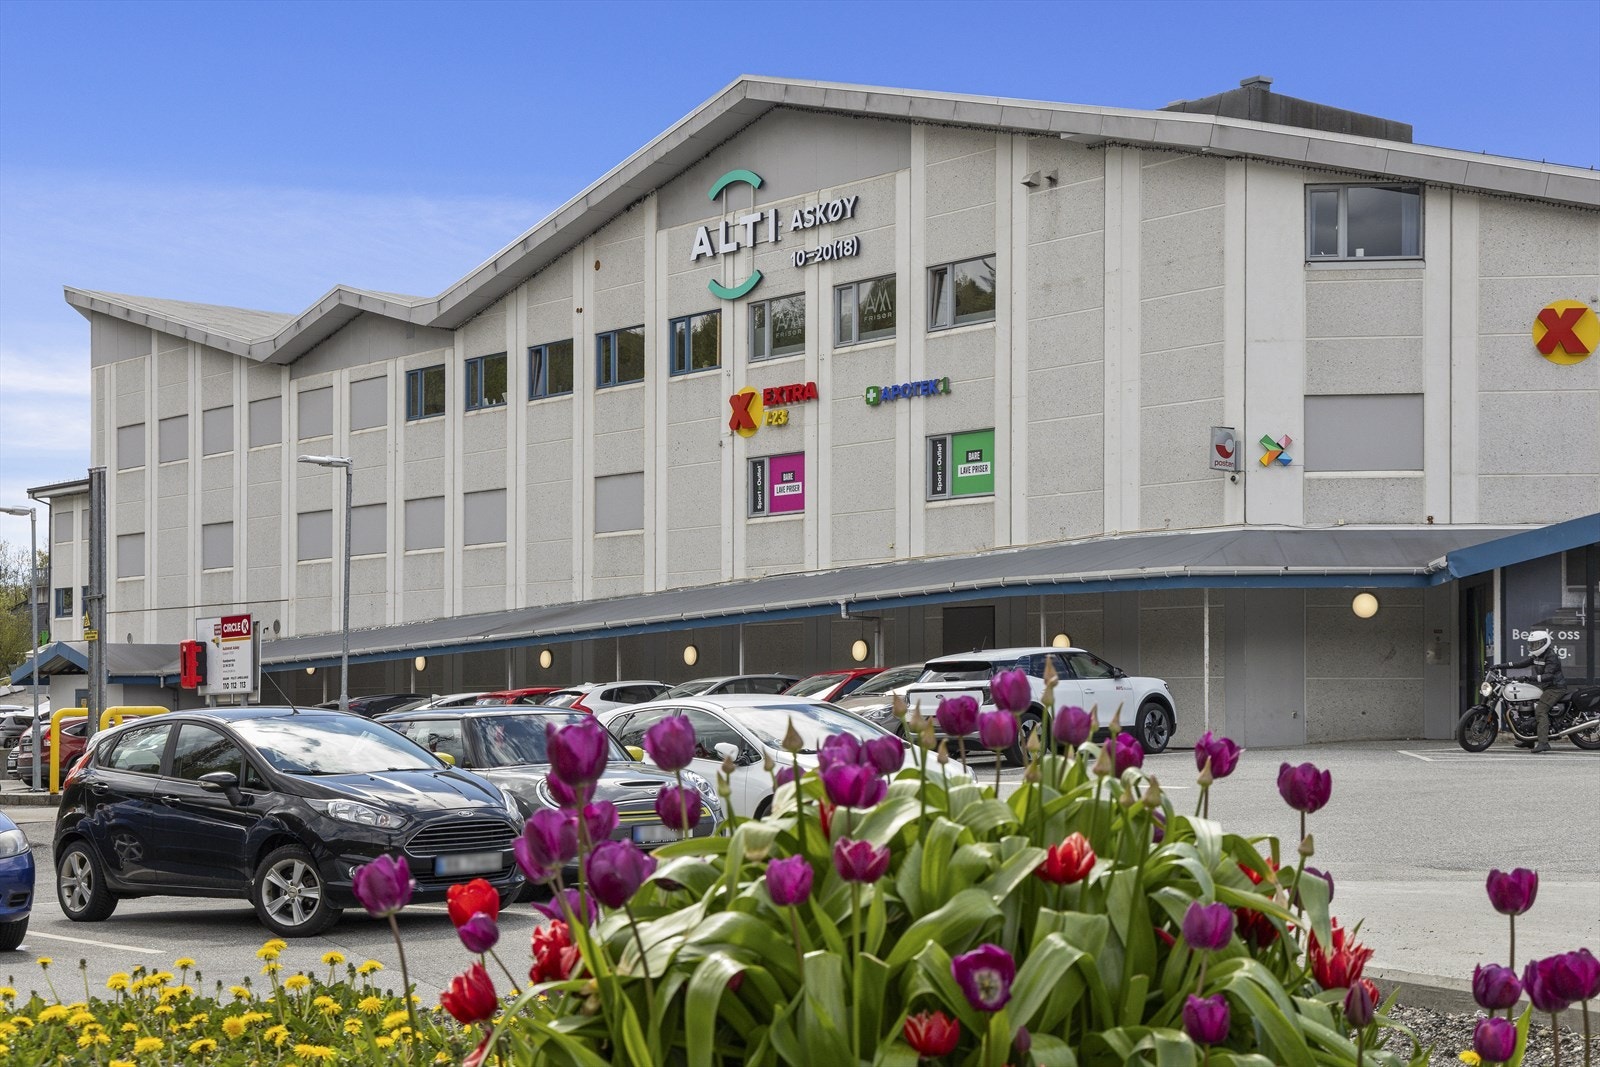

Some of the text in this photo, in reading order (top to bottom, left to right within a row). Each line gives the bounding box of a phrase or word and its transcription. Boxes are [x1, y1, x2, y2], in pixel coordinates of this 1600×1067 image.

[790, 195, 859, 231] ASKØY
[690, 208, 779, 261] ALTI
[864, 312, 893, 322] FRISØR
[763, 382, 818, 406] EXTRA
[880, 379, 940, 403] APOTEK
[968, 451, 981, 461] BARE
[960, 464, 988, 475] LAVE PRISER
[223, 622, 241, 633] CIRCLE
[1512, 628, 1580, 641] Bek oss
[1520, 645, 1524, 657] i
